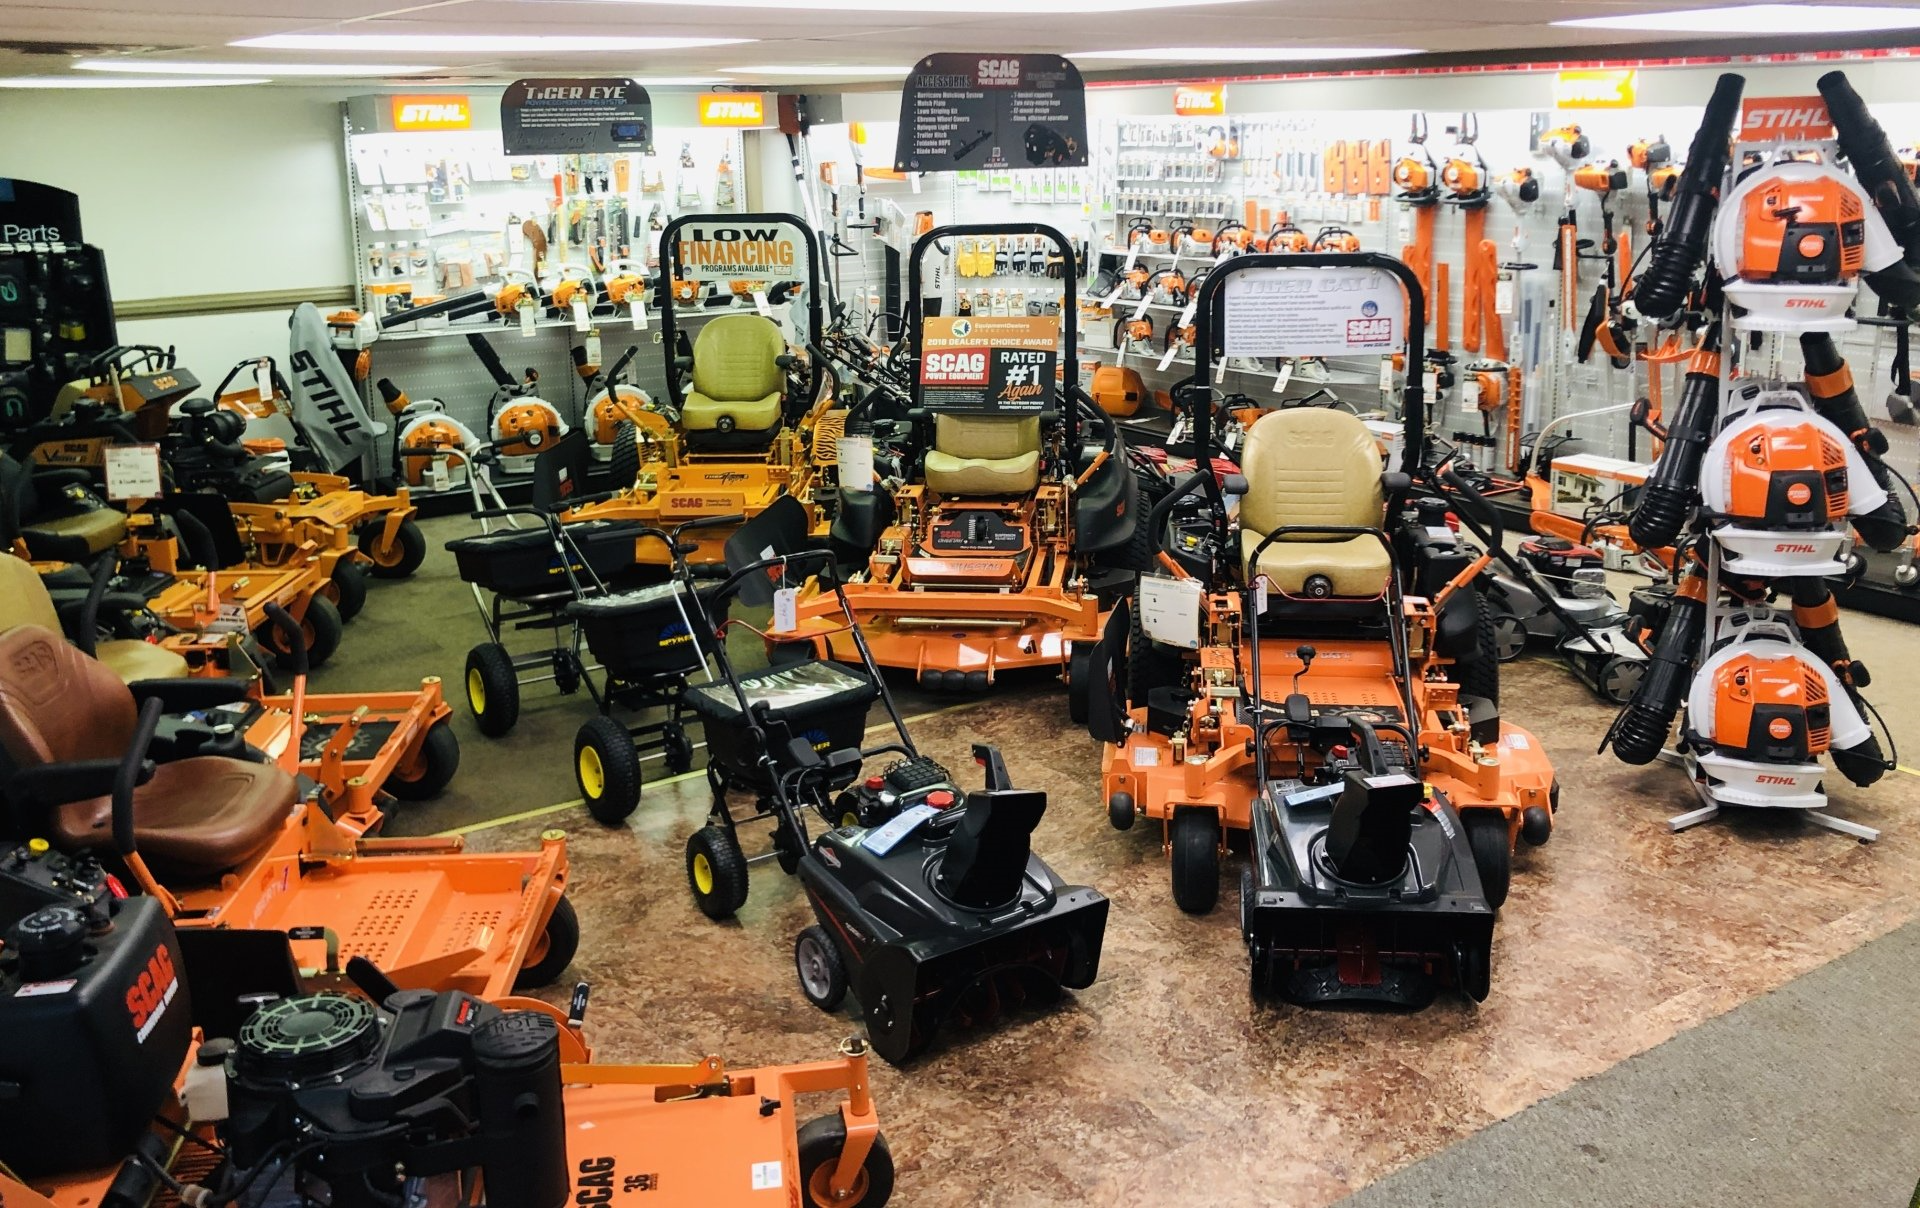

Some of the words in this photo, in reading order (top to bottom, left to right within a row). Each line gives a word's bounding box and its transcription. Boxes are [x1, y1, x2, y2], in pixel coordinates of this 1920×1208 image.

[978, 60, 1020, 78] SCAG
[915, 75, 972, 88] ACCESSORIES
[589, 87, 627, 99] EYE
[400, 104, 465, 122] STIHL
[706, 102, 760, 118] STIHL
[1743, 108, 1830, 128] STIHL
[3, 224, 60, 242] Parts
[693, 229, 779, 242] LOW
[679, 240, 794, 265] FINANCING
[701, 265, 737, 273] PROGRAMS
[1241, 279, 1314, 294] TIGER
[1317, 277, 1366, 293] CAT
[1784, 299, 1828, 308] STIHL
[1348, 320, 1391, 335] SCAG
[948, 338, 988, 346] DEALER'S
[990, 338, 1021, 346] CHOICE
[1023, 338, 1053, 346] AWARD
[926, 353, 985, 373] SCAG
[1000, 352, 1046, 364] RATED
[925, 372, 947, 380] POWER
[948, 372, 984, 380] EQUIPMENT
[1005, 364, 1040, 386] #1
[290, 350, 362, 446] STIHL
[997, 384, 1044, 401] Again
[671, 498, 703, 508] SCAG
[1774, 544, 1816, 553] STIHL
[1756, 775, 1796, 786] STIHL
[126, 943, 175, 1028] SCAG
[576, 1156, 616, 1208] CAG
[623, 1174, 650, 1193] 36
